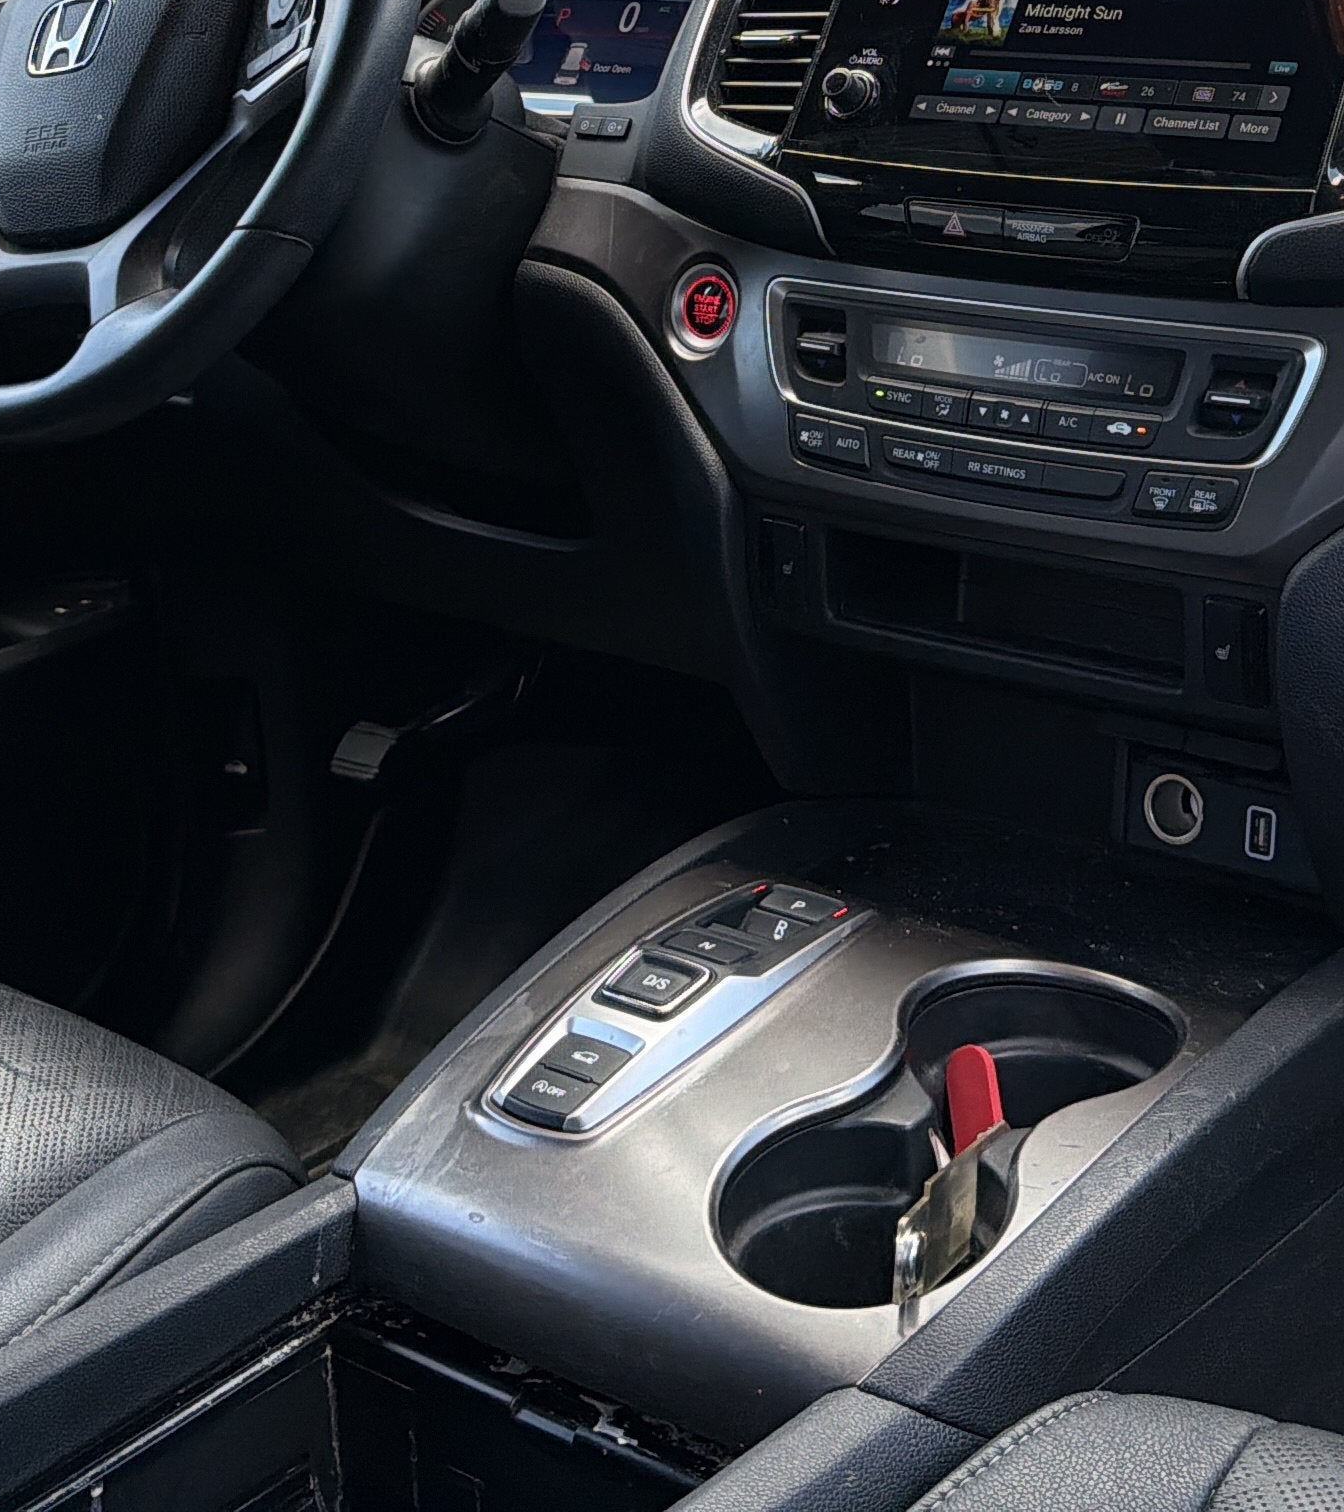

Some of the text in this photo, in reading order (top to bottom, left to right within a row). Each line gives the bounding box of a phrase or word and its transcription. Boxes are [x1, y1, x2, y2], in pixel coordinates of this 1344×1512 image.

[556, 8, 572, 27] P
[618, 1, 642, 34] 0
[1025, 4, 1123, 22] Midnight Sun
[1019, 24, 1084, 35] Zara Larsson
[1140, 86, 1155, 97] 26
[1231, 91, 1247, 102] 74
[936, 102, 977, 115] Channel
[1026, 108, 1072, 123] Category
[1153, 116, 1220, 131] Channel List
[1239, 122, 1270, 135] More
[1087, 372, 1120, 385] A/C ON
[886, 391, 913, 404] SYNC
[1058, 415, 1078, 428] A/C
[835, 437, 860, 450] AUTO
[892, 447, 916, 460] REAR
[923, 459, 940, 470] OFF
[967, 461, 1027, 480] RR SETTINGS
[1149, 487, 1176, 497] FRONT
[1194, 489, 1217, 500] REAR
[789, 899, 807, 911] P
[774, 919, 790, 936] R
[642, 974, 671, 991] D/S
